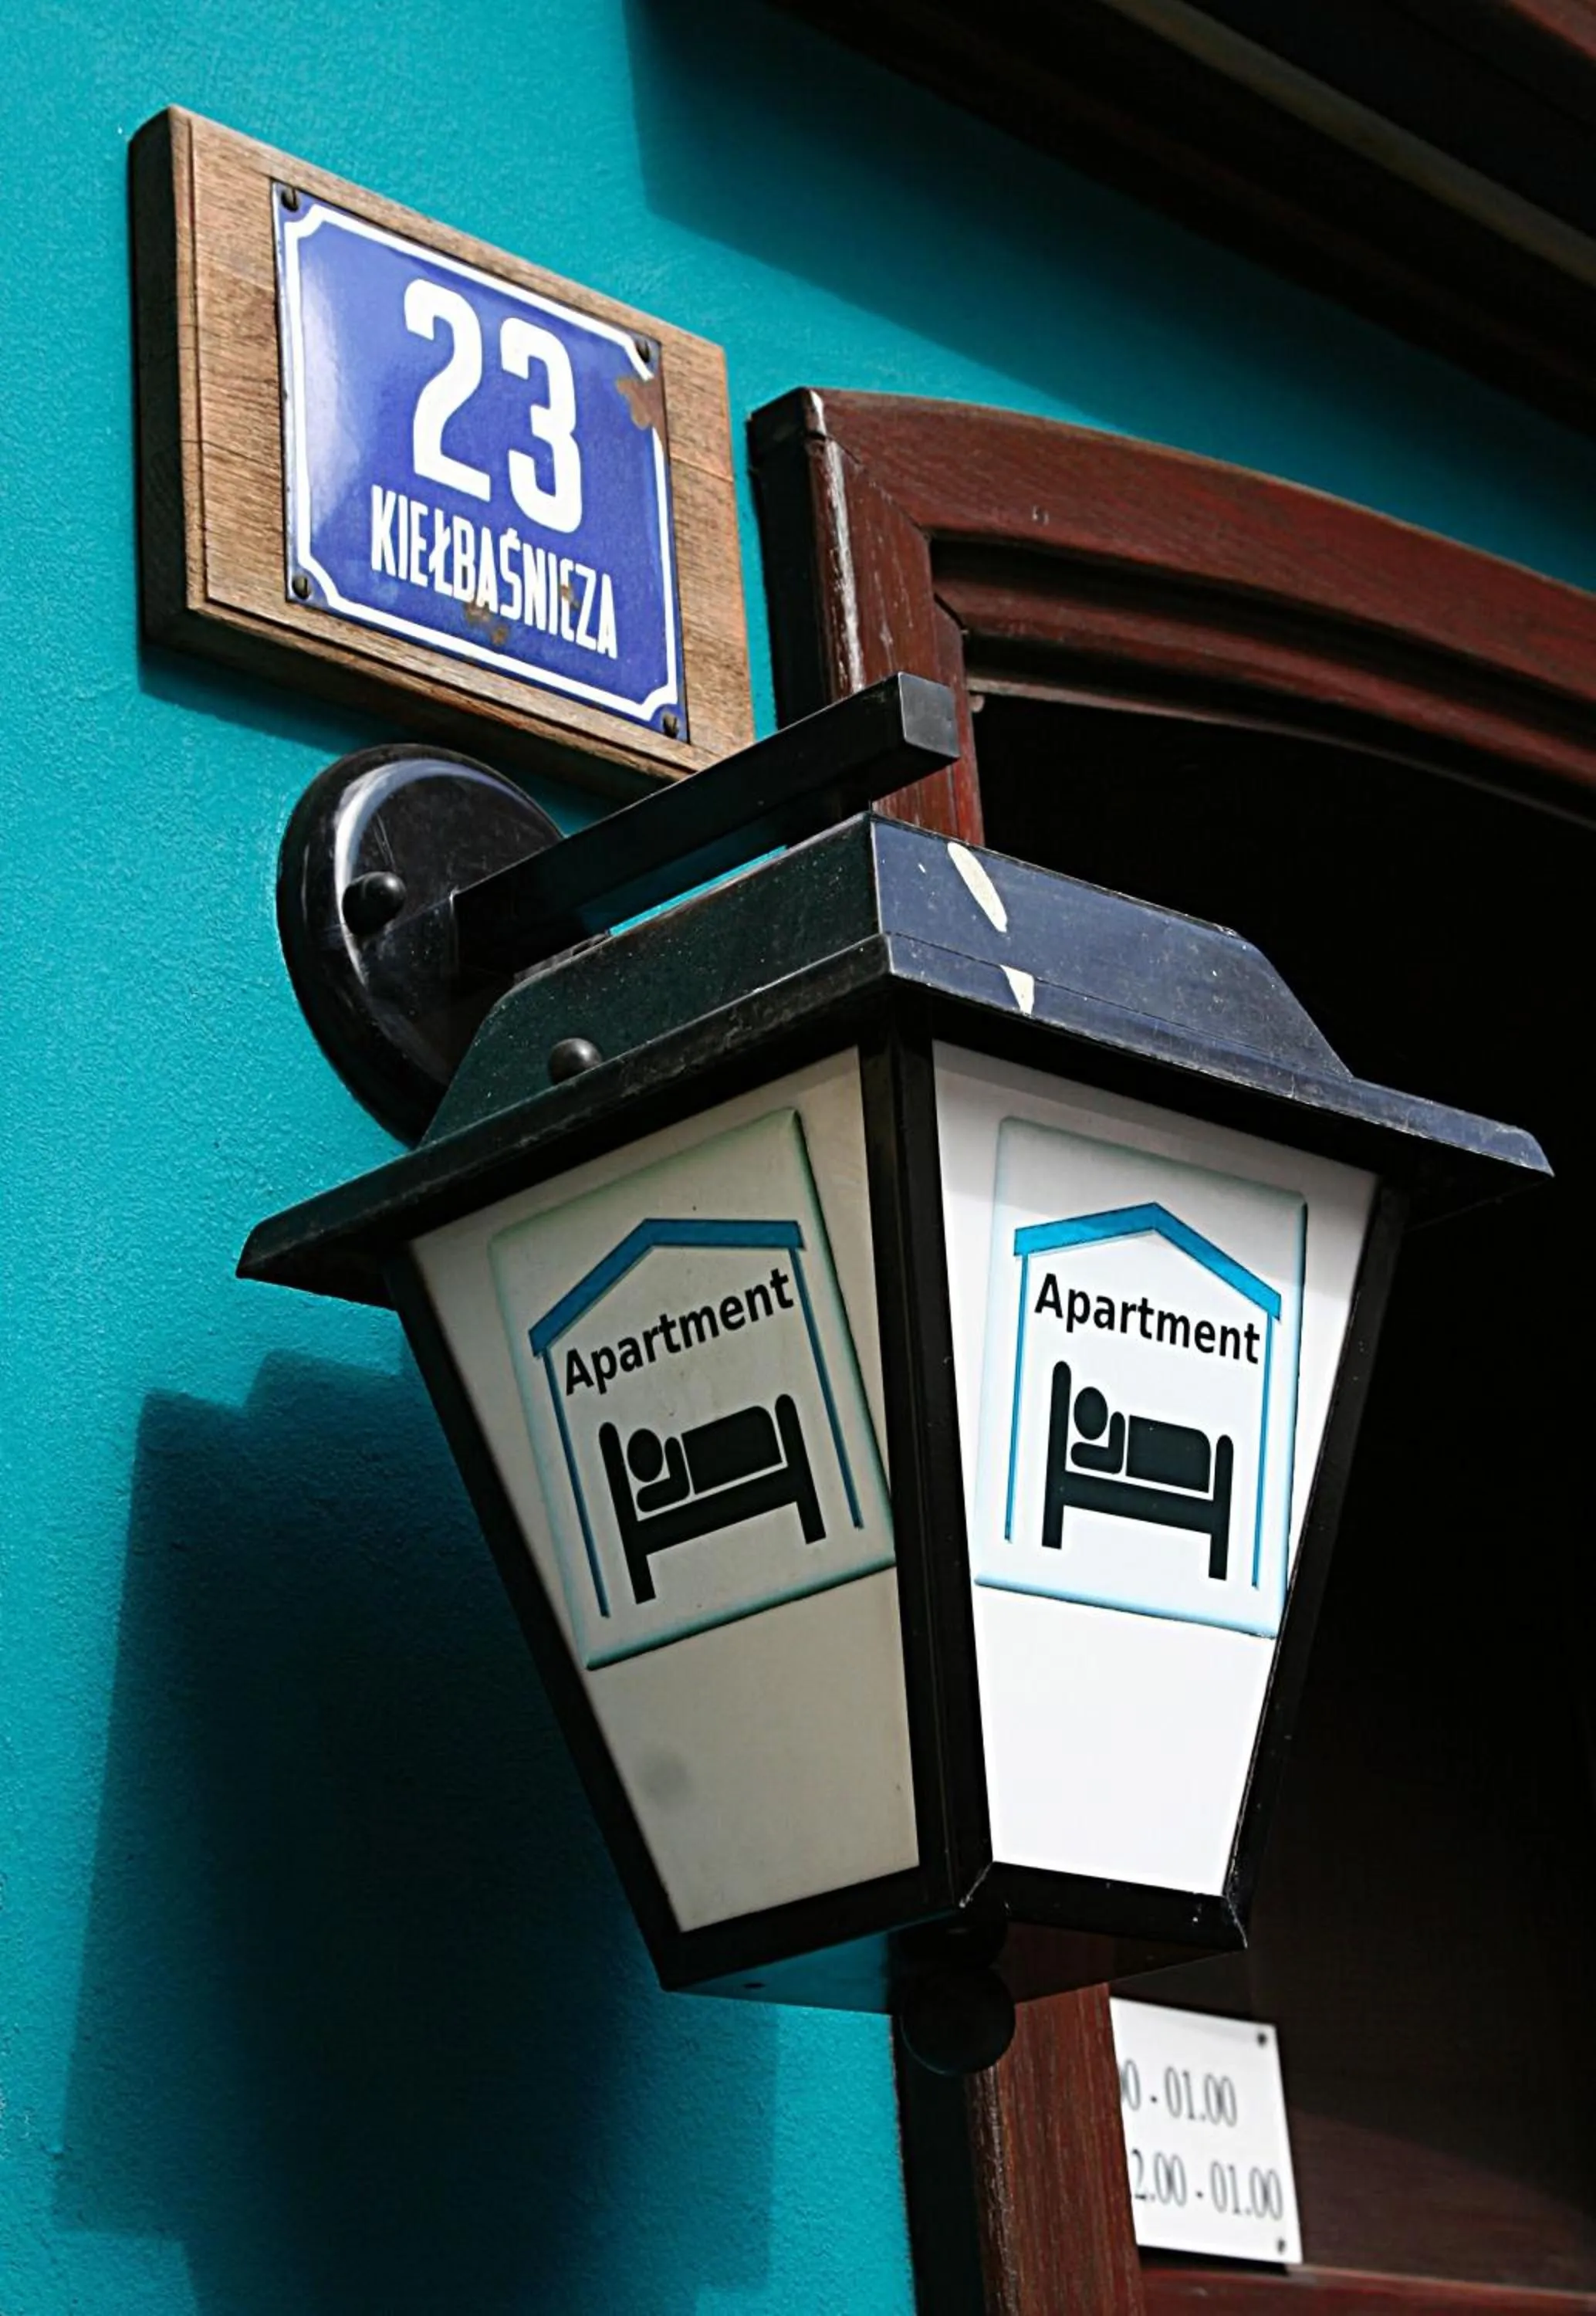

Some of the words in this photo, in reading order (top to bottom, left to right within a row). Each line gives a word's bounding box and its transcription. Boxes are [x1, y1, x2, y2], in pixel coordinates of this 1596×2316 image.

[404, 278, 582, 533] 23
[370, 484, 618, 659] KIEŁBAŚNICZA
[563, 1267, 795, 1395] Apartment
[1034, 1273, 1261, 1365] Apartment
[1121, 2058, 1141, 2111] 0
[1164, 2066, 1237, 2127] 01.00
[1210, 2160, 1283, 2221] 01.00
